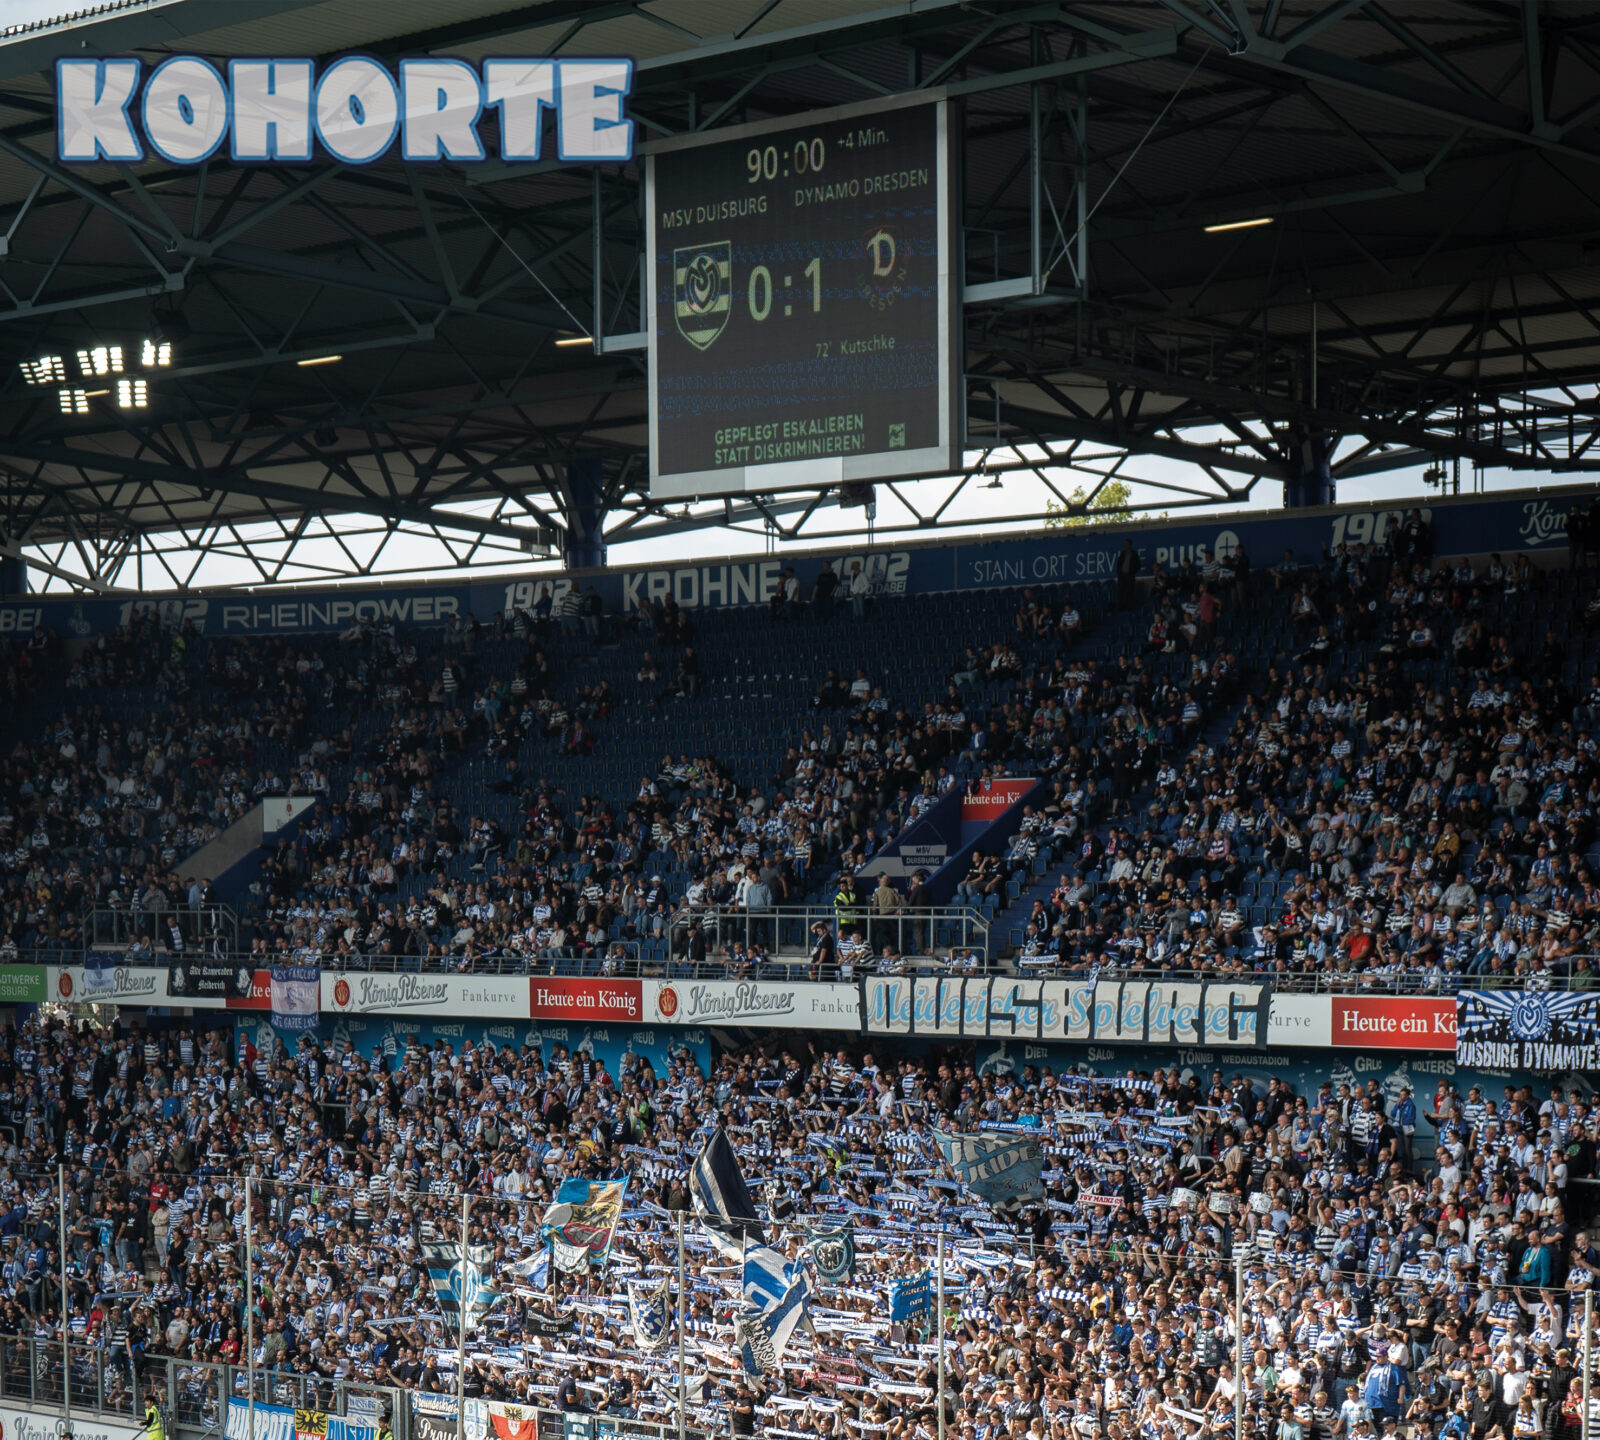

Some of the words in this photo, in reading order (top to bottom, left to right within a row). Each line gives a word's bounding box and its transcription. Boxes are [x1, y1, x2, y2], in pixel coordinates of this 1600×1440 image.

[747, 137, 825, 183] 90:00
[858, 127, 889, 148] Min.
[795, 180, 859, 206] DYNAMO
[864, 168, 928, 195] DRESDEN
[662, 208, 693, 229] MSV
[697, 196, 767, 223] DUISBURG
[841, 336, 895, 355] Kutschke
[715, 422, 779, 445] GEPFLEGT
[783, 414, 864, 439] ESKALIEREN
[715, 443, 750, 465] STATT
[754, 434, 865, 461] DISKRIMINIEREN!
[622, 561, 782, 612] KROHNE
[223, 596, 459, 629] RHEINPOWER
[905, 857, 940, 866] DUISBURG
[915, 846, 931, 855] MSV
[462, 988, 516, 1004] Fankurve
[537, 987, 571, 1008] Heute
[572, 989, 596, 1009] ein
[598, 989, 637, 1016] König
[1341, 1009, 1398, 1033] Heute
[1400, 1010, 1436, 1034] ein
[1221, 1053, 1290, 1067] WEDAUSTADION
[1411, 1058, 1456, 1076] WOLTERS
[1456, 1040, 1520, 1068] DUISBURG
